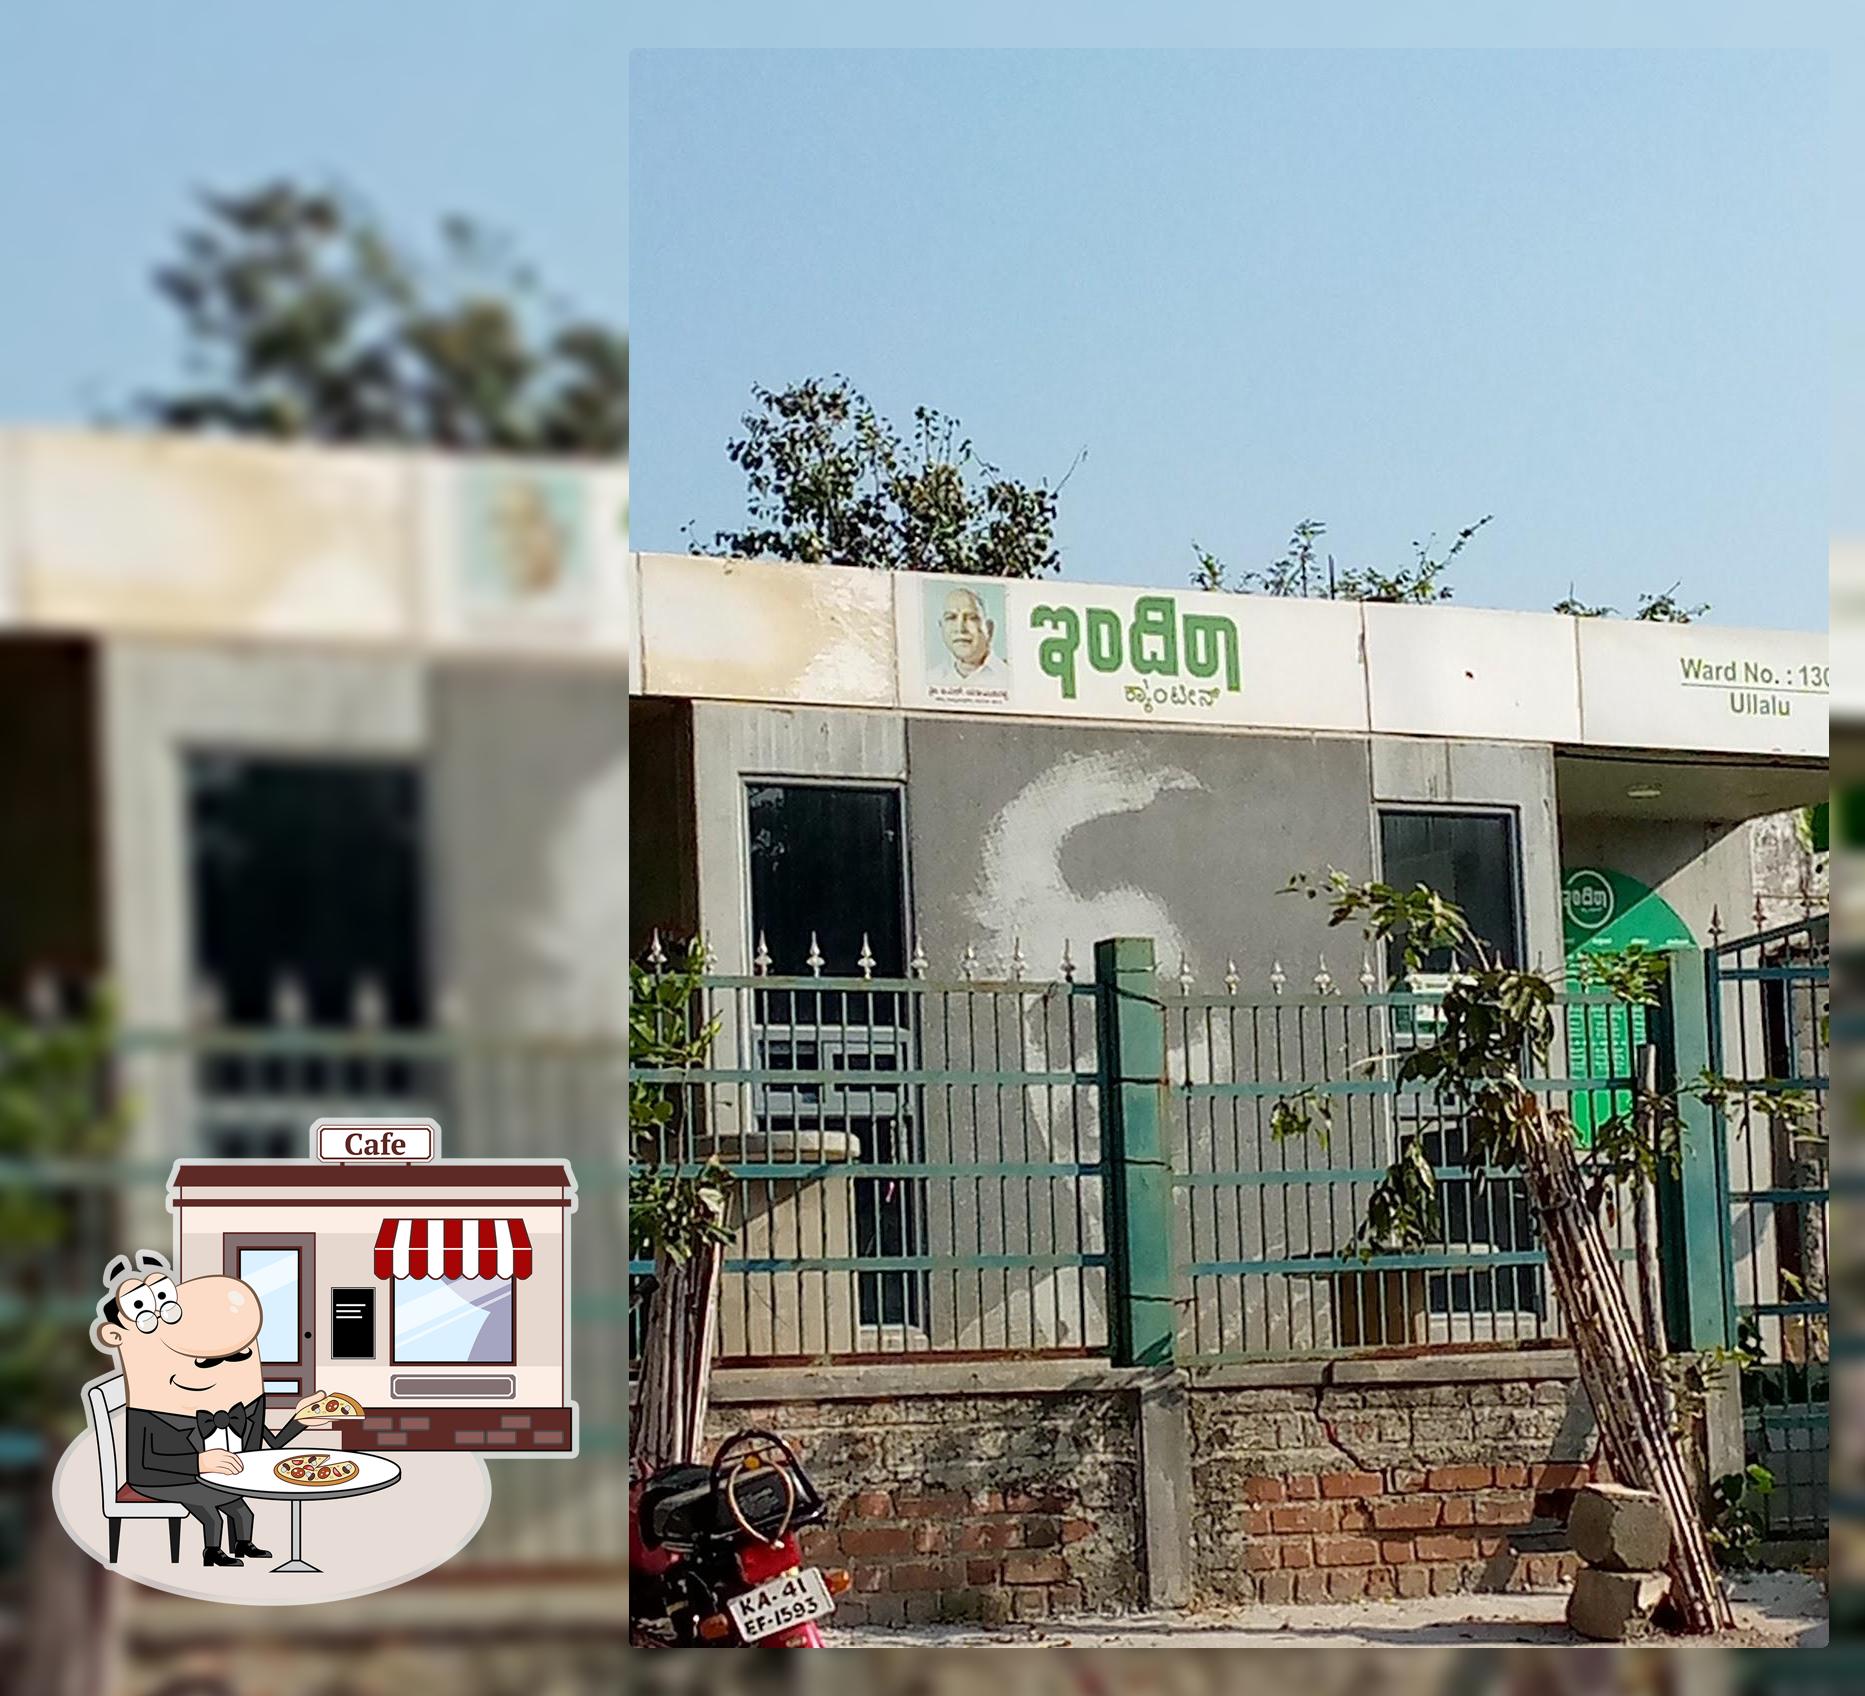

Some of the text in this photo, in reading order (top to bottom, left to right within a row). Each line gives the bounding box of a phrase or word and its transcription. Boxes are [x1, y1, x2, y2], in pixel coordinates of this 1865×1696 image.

[1030, 597, 1241, 699] ಇಂದಿರಾ
[1680, 657, 1736, 681] Ward
[1730, 692, 1790, 716] Ullalu
[744, 1597, 818, 1636] EF-1593
